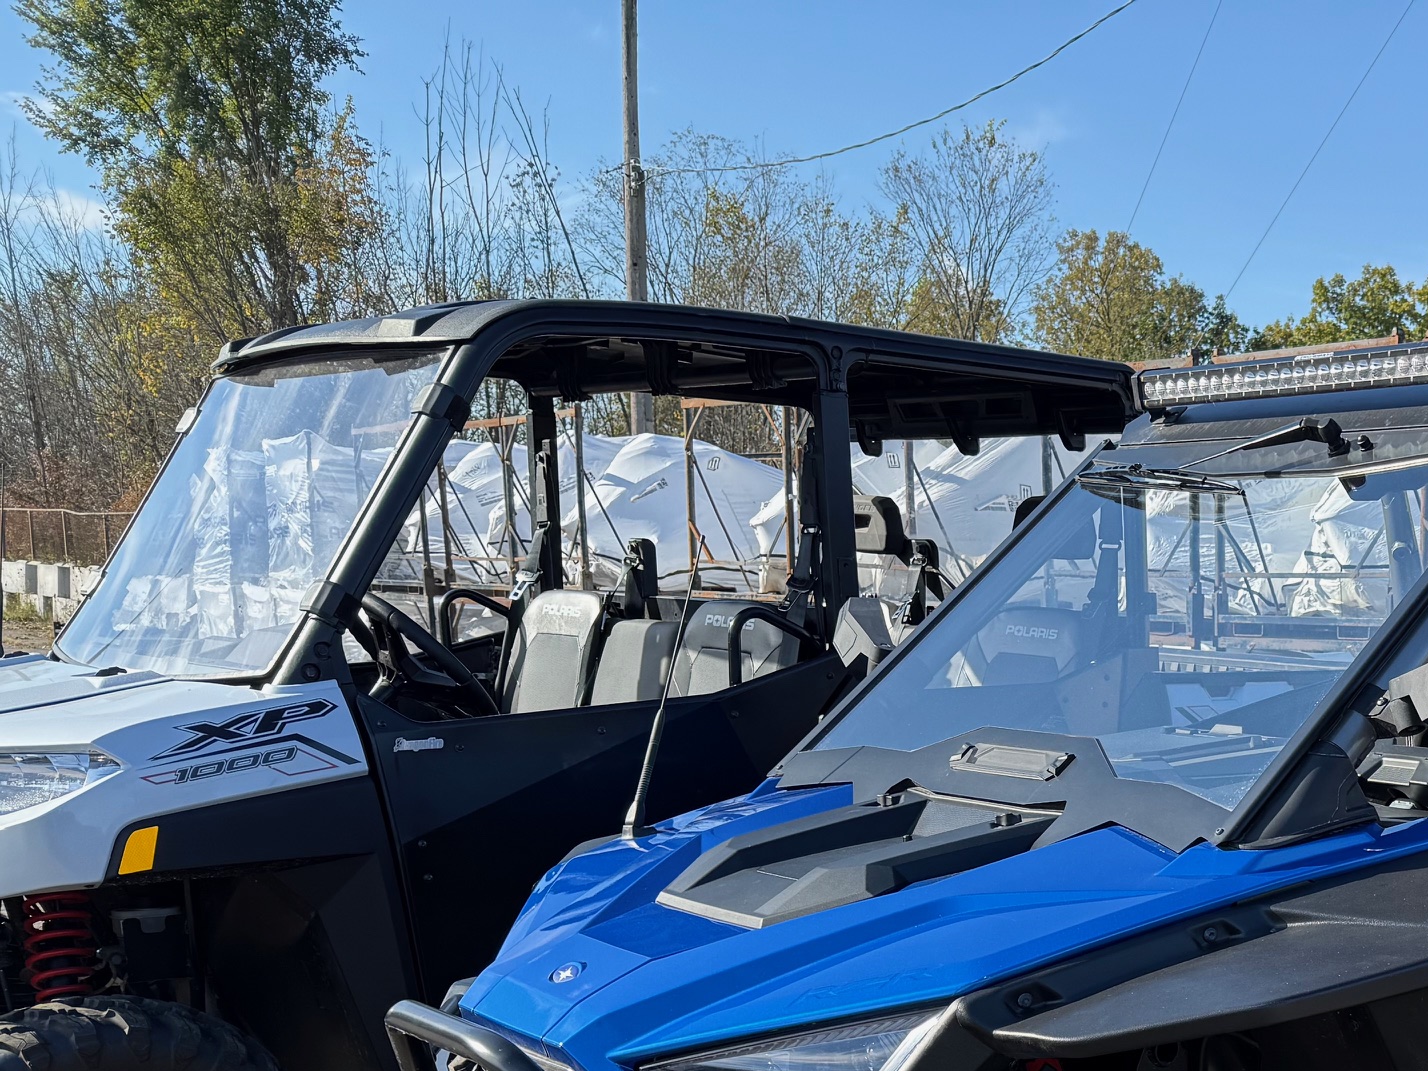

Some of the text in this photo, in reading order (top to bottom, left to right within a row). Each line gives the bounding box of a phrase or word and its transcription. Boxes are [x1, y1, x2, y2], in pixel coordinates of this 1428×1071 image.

[542, 604, 581, 617] POLARIS
[1005, 625, 1059, 639] POLARIS
[150, 698, 338, 761] XP
[173, 744, 299, 785] 1000
